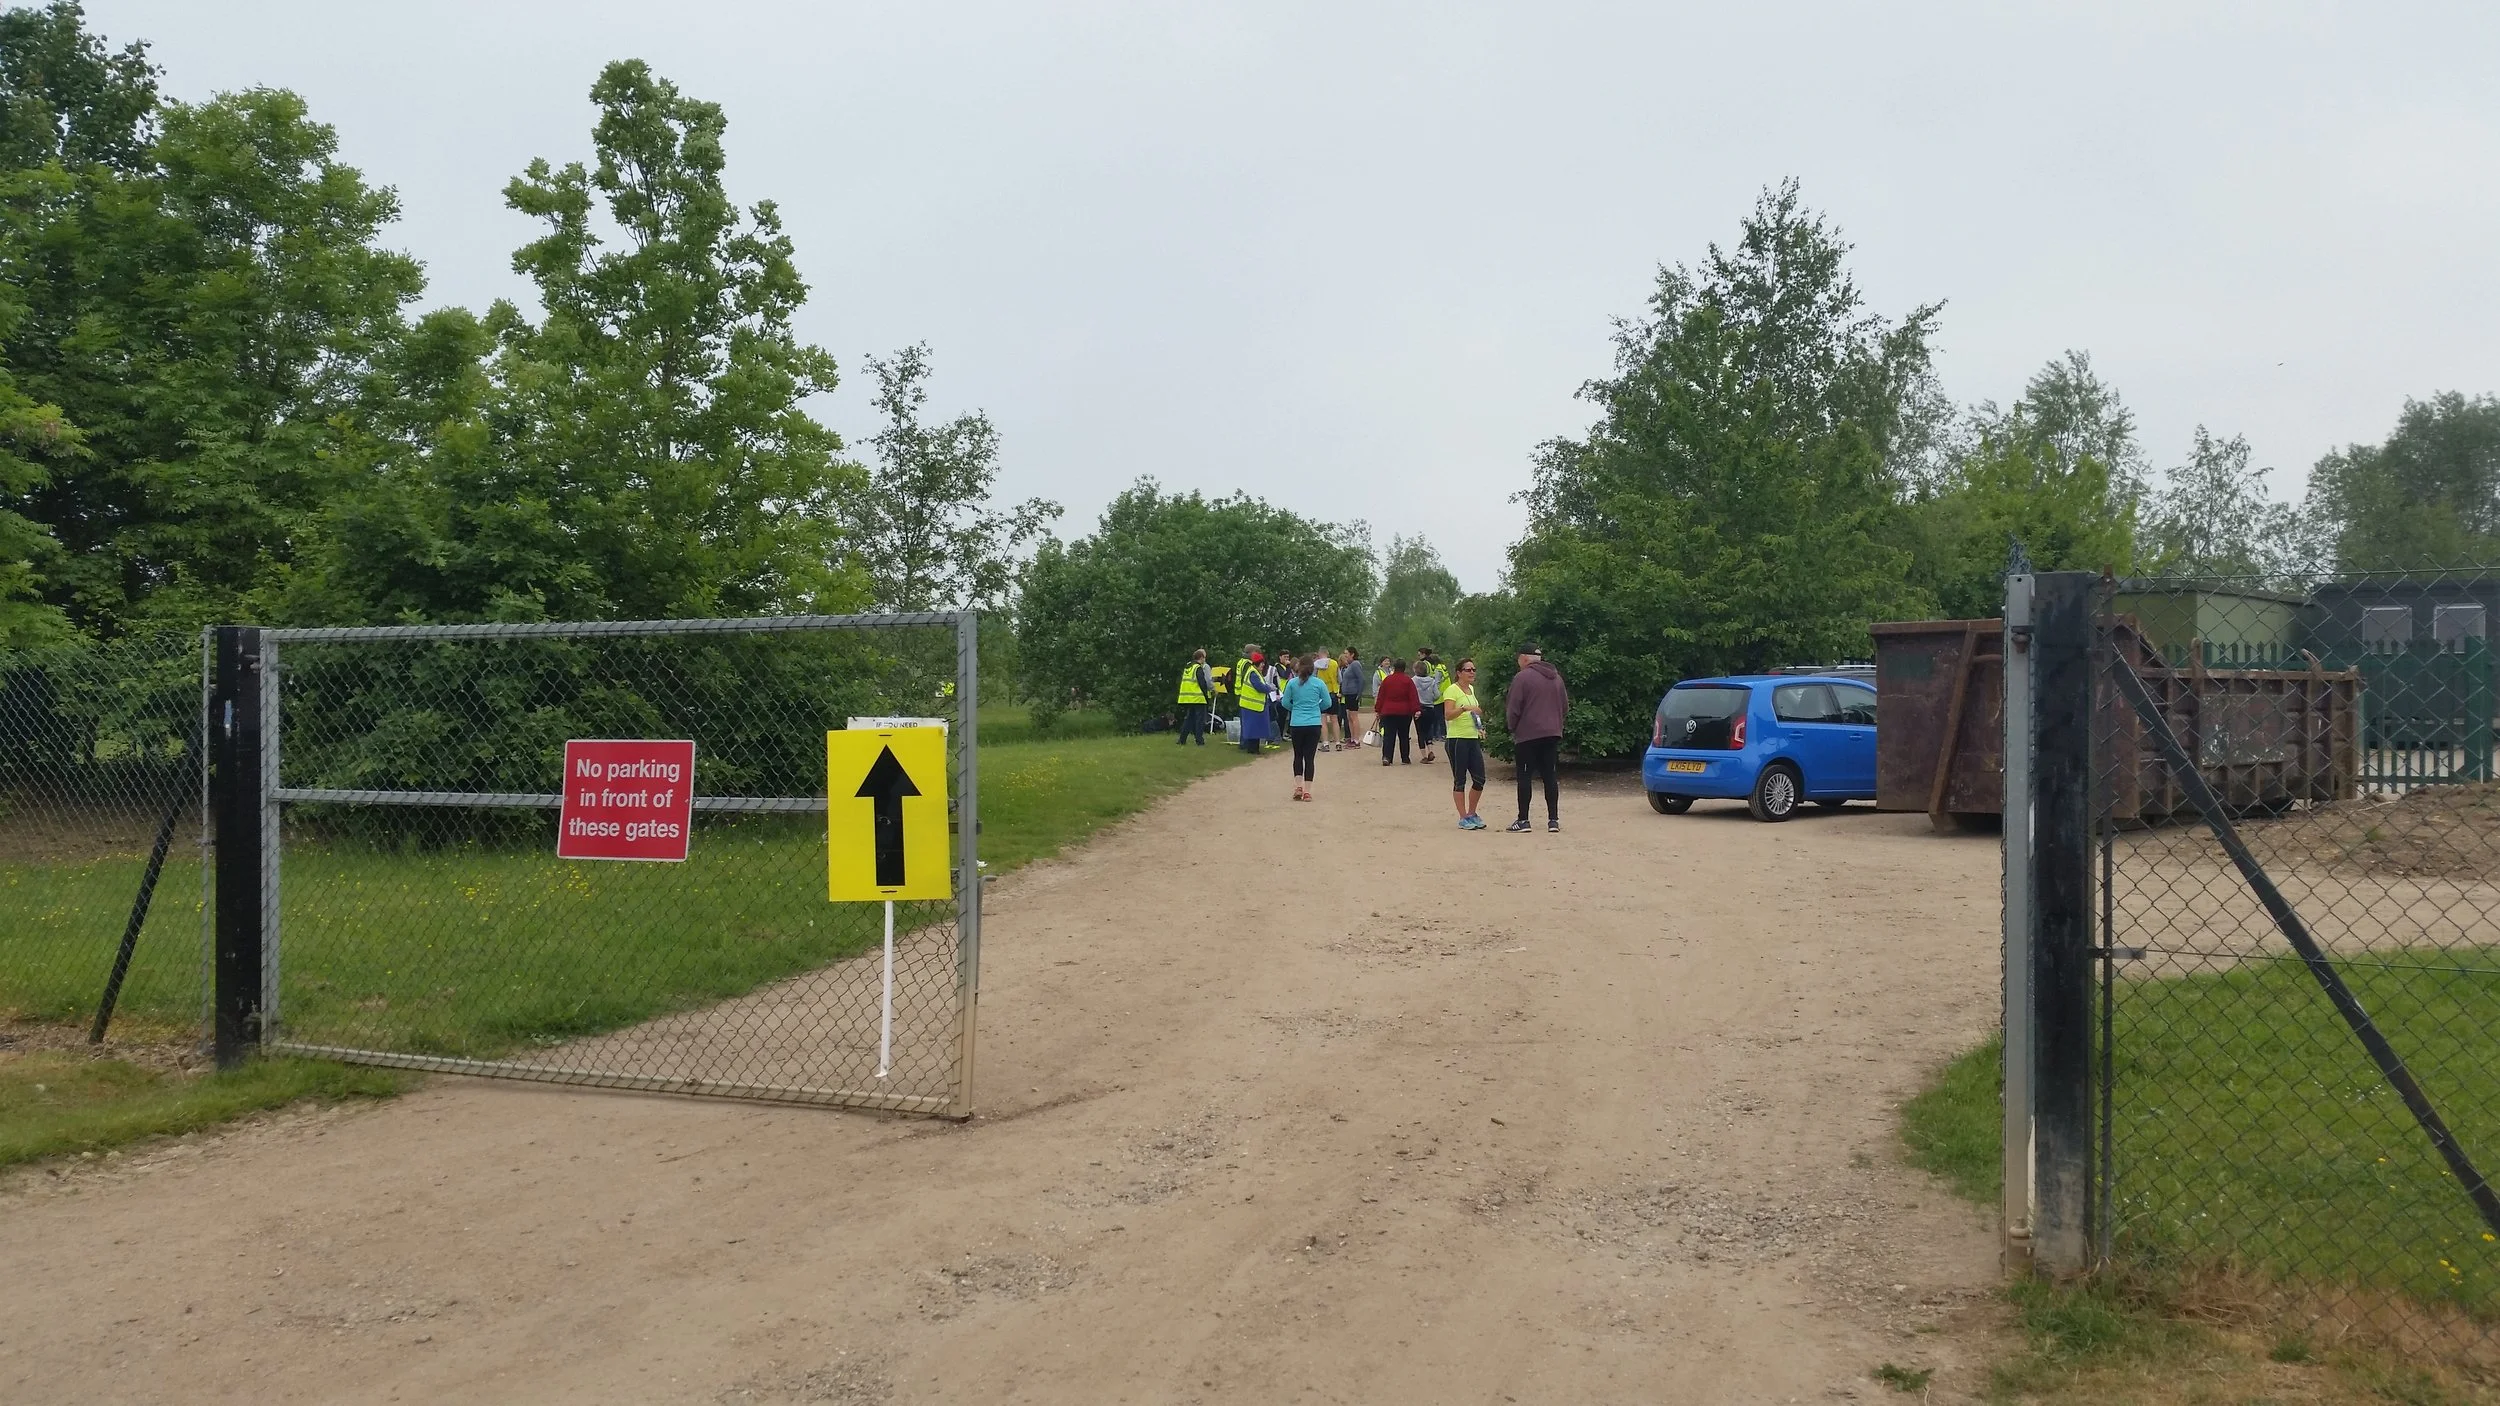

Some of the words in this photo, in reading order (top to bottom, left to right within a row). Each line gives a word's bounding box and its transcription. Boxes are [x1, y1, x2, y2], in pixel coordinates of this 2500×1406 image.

[576, 759, 602, 778] No
[607, 759, 680, 782] parking
[579, 788, 596, 807] in
[601, 788, 648, 807] front
[652, 789, 674, 808] of
[568, 817, 620, 837] these
[625, 820, 680, 841] gates
